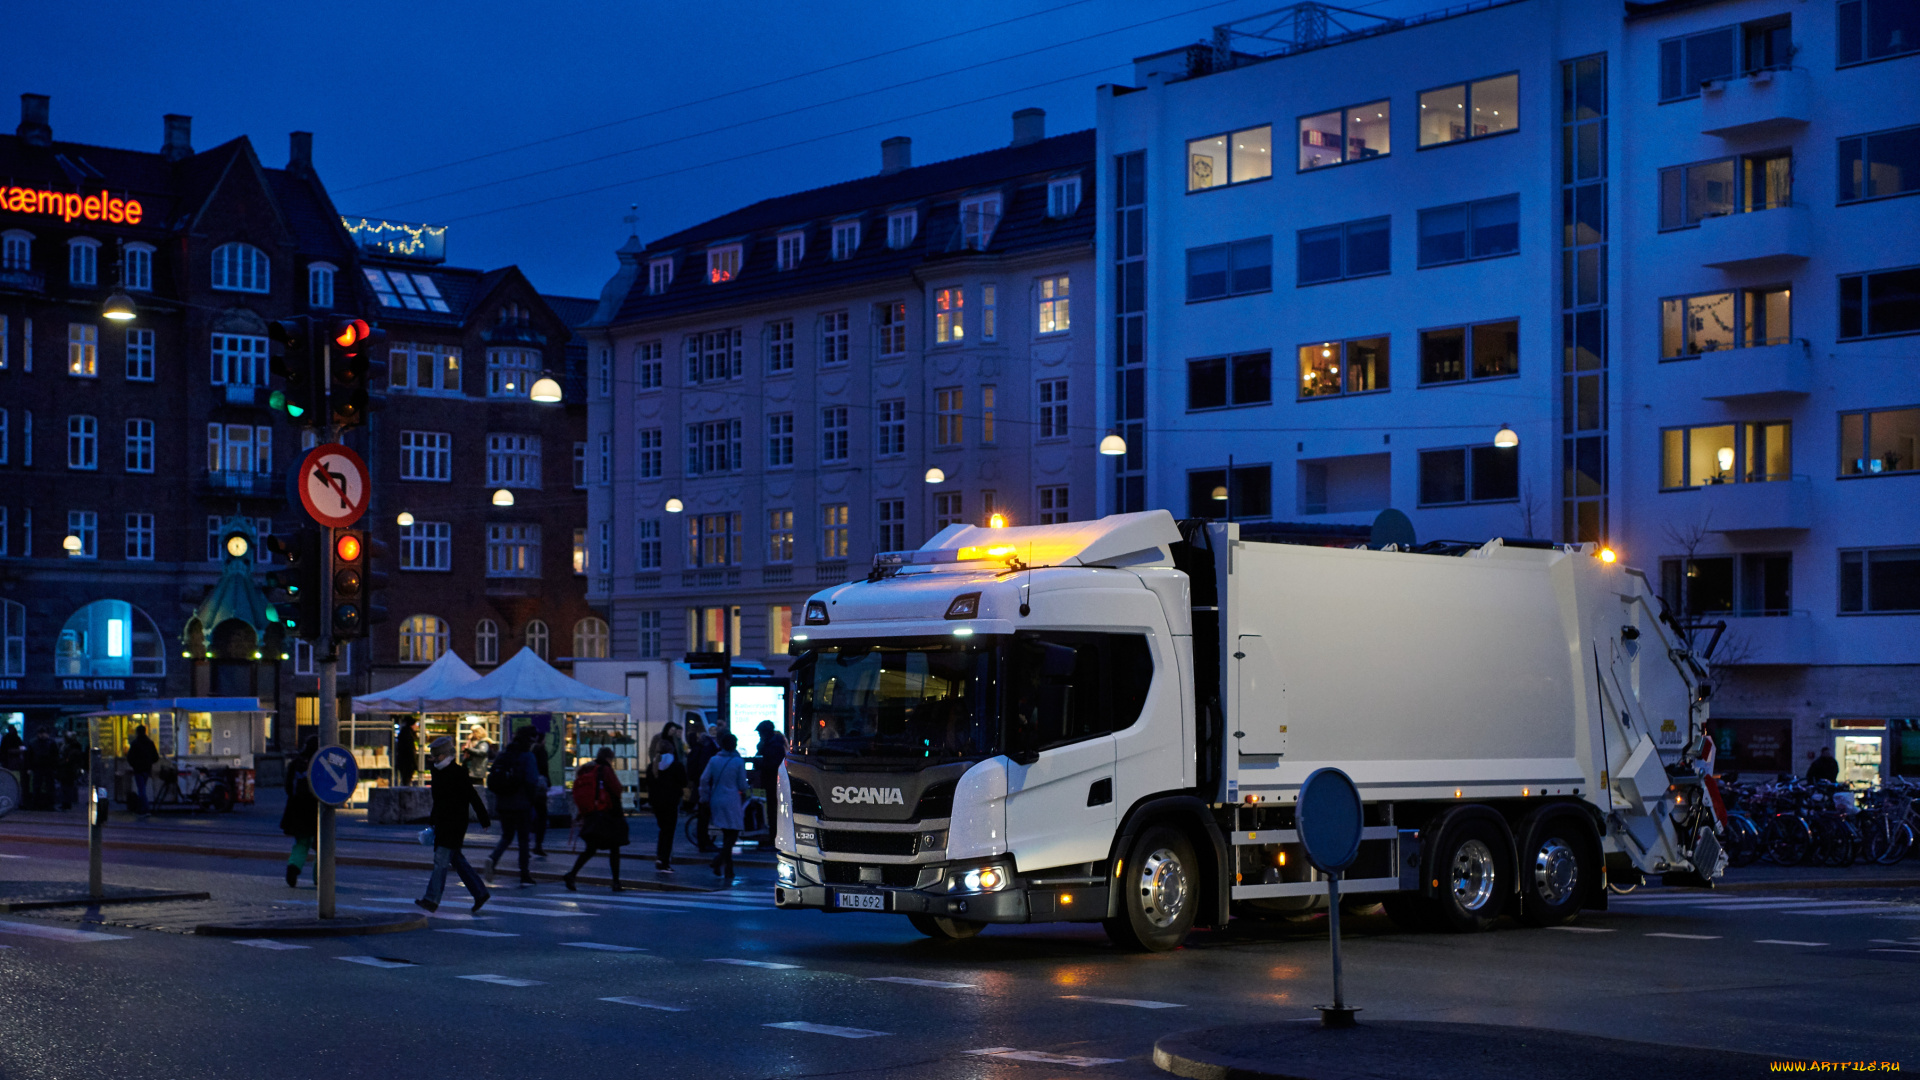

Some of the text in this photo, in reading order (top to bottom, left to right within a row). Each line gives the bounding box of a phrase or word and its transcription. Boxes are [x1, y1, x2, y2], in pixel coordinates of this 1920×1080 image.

[63, 679, 84, 690] STAR
[831, 786, 904, 805] SCANIA
[842, 894, 880, 908] MLB 692
